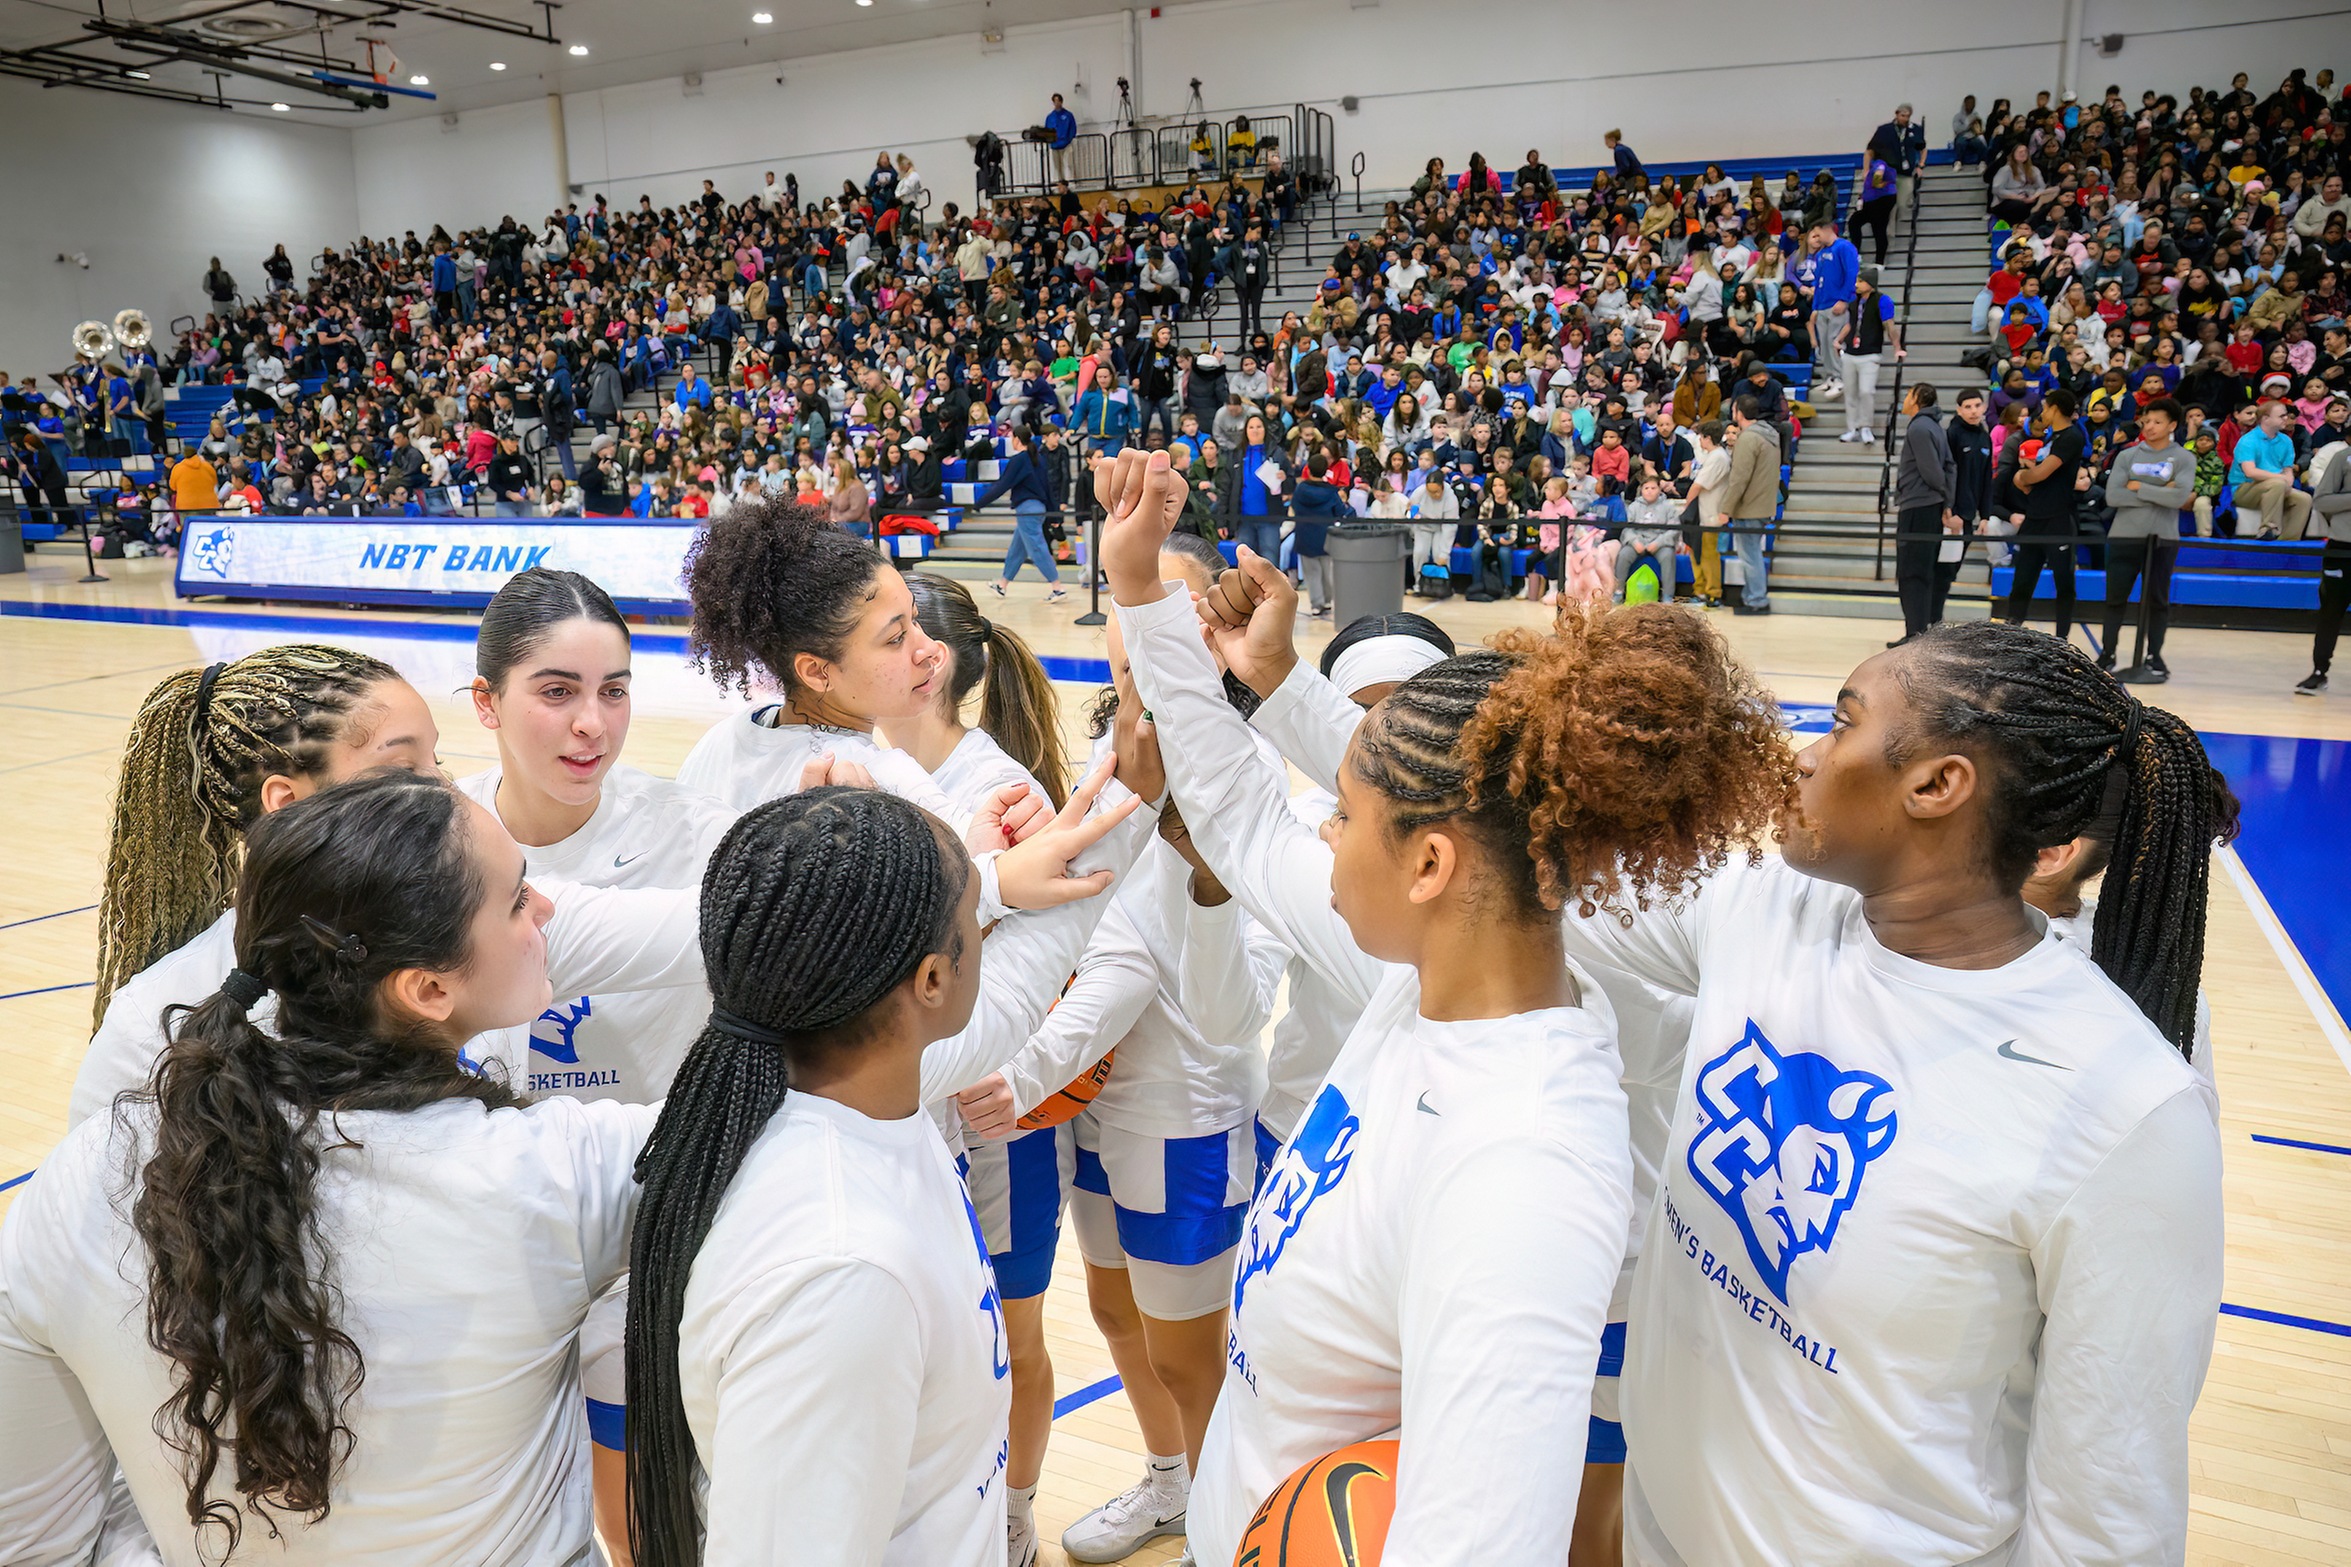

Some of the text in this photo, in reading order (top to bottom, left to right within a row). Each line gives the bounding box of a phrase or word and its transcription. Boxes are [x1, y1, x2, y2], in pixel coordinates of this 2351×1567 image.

[359, 543, 552, 572] NBT BANK
[1700, 1249, 1839, 1375] BASKETBALL
